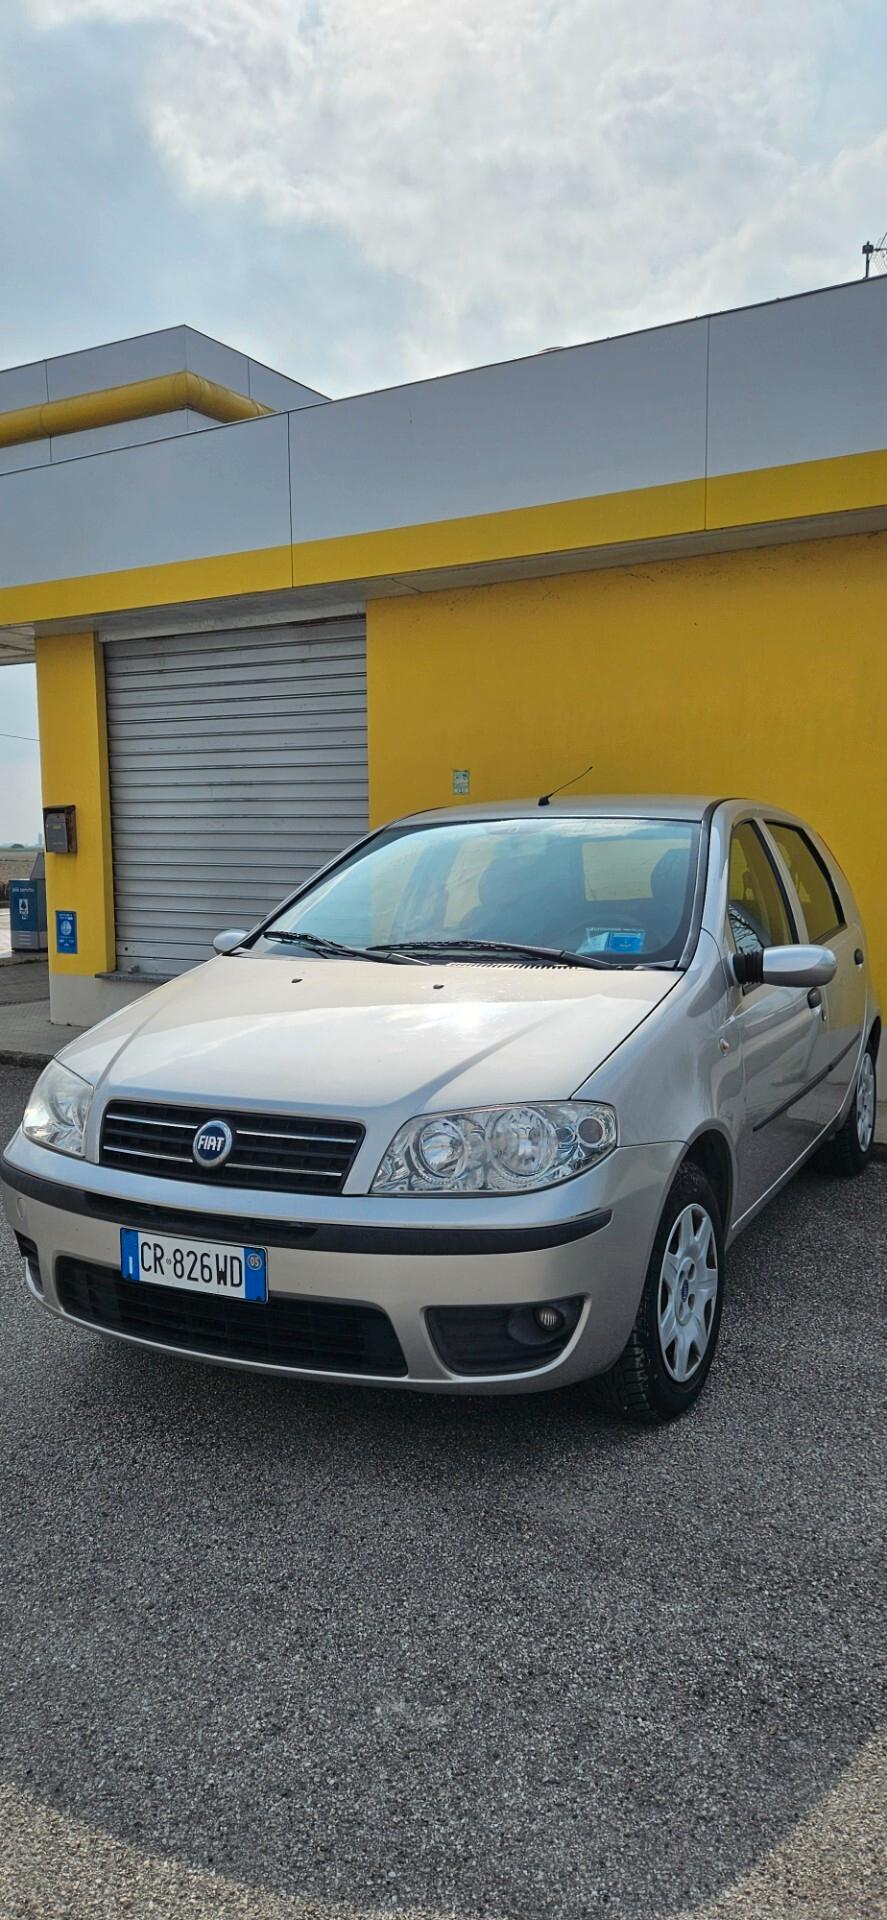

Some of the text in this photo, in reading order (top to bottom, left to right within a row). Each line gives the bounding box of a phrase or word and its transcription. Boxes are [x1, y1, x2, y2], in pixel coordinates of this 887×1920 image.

[198, 1135, 225, 1152] FIAT
[128, 1256, 134, 1275] I
[173, 1249, 243, 1287] 826WD
